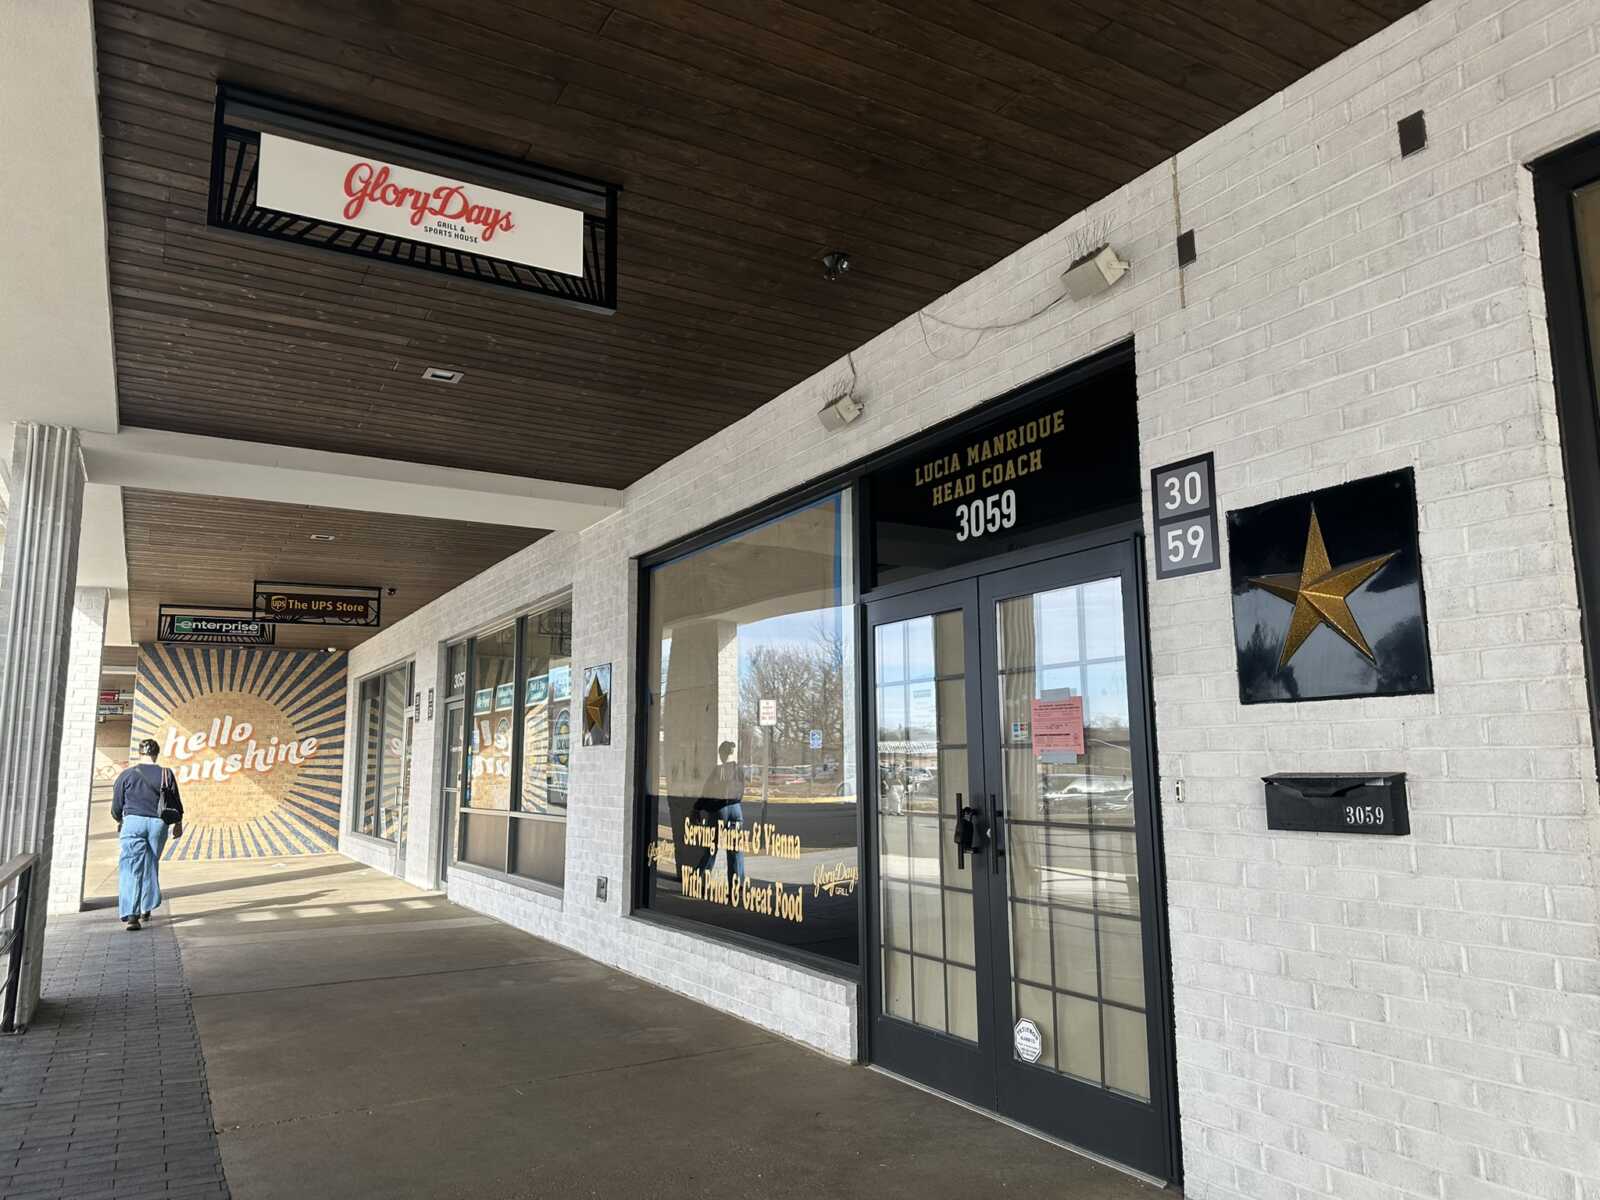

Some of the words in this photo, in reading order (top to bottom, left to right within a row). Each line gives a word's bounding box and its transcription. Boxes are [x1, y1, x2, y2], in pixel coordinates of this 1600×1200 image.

[424, 225, 453, 238] SPORTS
[454, 232, 478, 244] HOUSE
[436, 220, 458, 232] GRILL
[460, 225, 466, 233] &
[914, 453, 961, 487] LUCIA
[966, 409, 1065, 467] MANRIQUE
[932, 473, 977, 507] HEAD
[981, 449, 1043, 489] COACH
[1163, 471, 1202, 510] 30
[955, 488, 1017, 542] 3059
[1167, 525, 1205, 562] 59
[288, 599, 308, 610] The
[311, 600, 333, 612] UPS
[336, 600, 365, 612] Store
[179, 620, 258, 632] enterprise
[163, 715, 253, 760] hello
[173, 736, 318, 784] unshine
[1346, 806, 1384, 824] 3059
[684, 816, 716, 855] Serving
[717, 819, 750, 853] Fairfax
[752, 822, 761, 855] &
[763, 823, 801, 860] Vienna
[681, 865, 702, 898] With
[704, 868, 729, 905] Pride
[731, 872, 740, 908] &
[742, 877, 772, 916] Great
[774, 881, 803, 923] Food
[835, 886, 849, 896] GRILL
